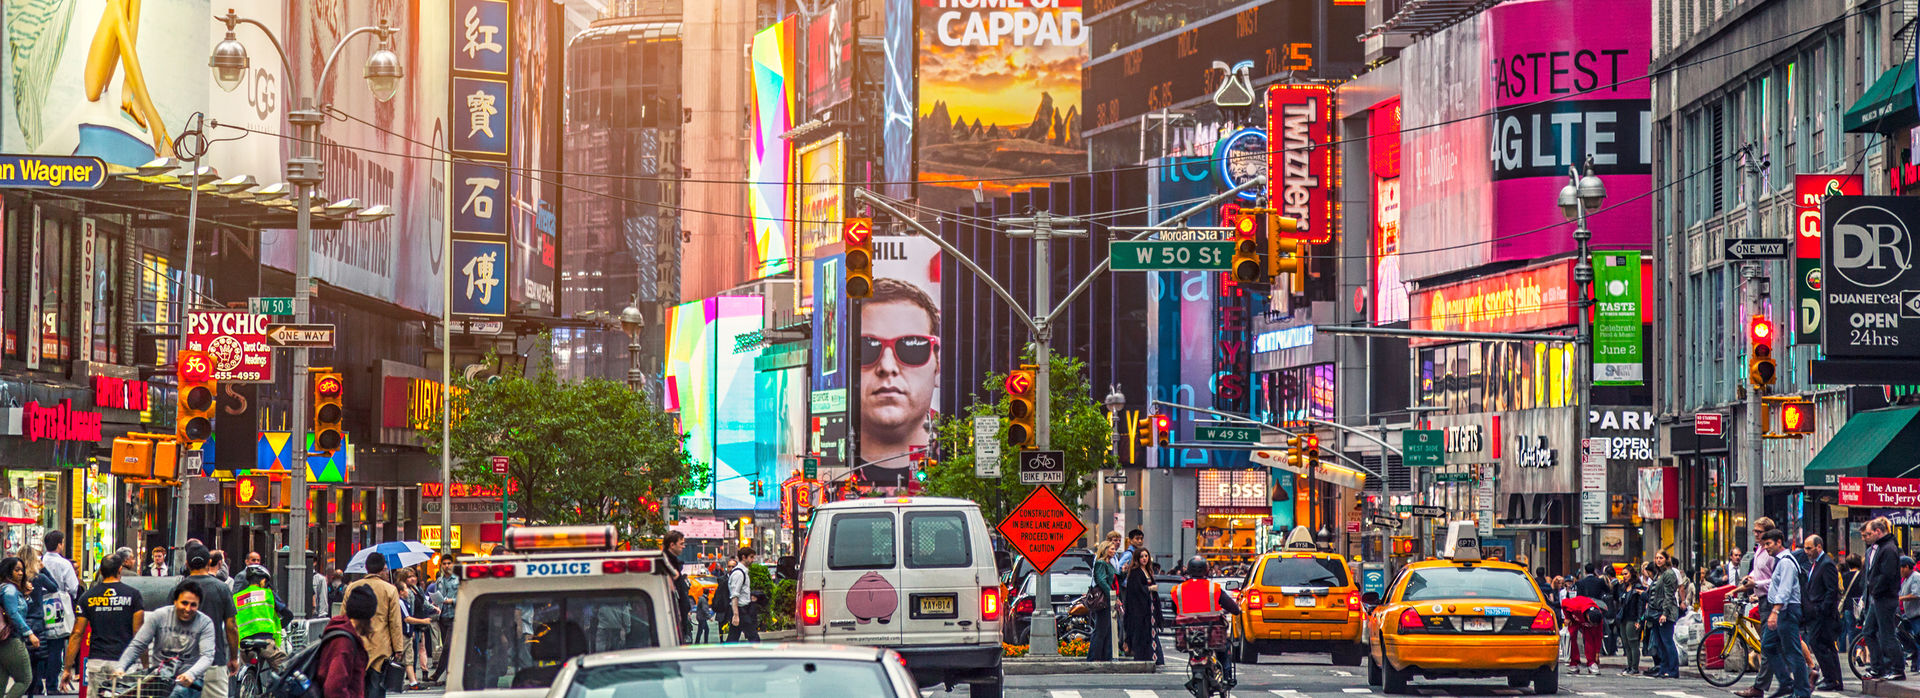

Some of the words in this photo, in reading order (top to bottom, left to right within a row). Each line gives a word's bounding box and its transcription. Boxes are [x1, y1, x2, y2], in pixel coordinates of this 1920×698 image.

[1491, 50, 1629, 99] FASTEST
[1490, 115, 1522, 171] 4G
[1532, 111, 1617, 168] LTE
[19, 159, 93, 187] Wagner
[1736, 244, 1755, 254] ONE
[1758, 244, 1780, 254] WAY
[1136, 248, 1154, 264] W
[1162, 247, 1191, 264] 50
[1198, 247, 1222, 264] St
[261, 301, 270, 313] W
[272, 300, 284, 313] 50
[1447, 299, 1464, 325] new
[1465, 287, 1485, 331] york
[1485, 282, 1514, 328] sports
[1515, 276, 1541, 315] clubs
[1599, 302, 1636, 312] TASTE
[187, 312, 268, 336] PSYCHIC
[1849, 312, 1899, 329] OPEN
[1600, 324, 1636, 333] Celebrate
[278, 331, 299, 341] ONE
[304, 331, 325, 340] WAY
[1849, 329, 1900, 346] 24hrs
[1600, 346, 1627, 355] June
[1629, 345, 1637, 355] 2
[1207, 430, 1216, 439] W
[1219, 430, 1234, 439] 49
[1237, 430, 1249, 440] St
[1612, 437, 1649, 449] OPEN
[1612, 449, 1628, 460] 24
[1024, 473, 1040, 481] BIKE
[1042, 472, 1061, 481] PATH
[1867, 483, 1884, 493] The
[1885, 483, 1908, 493] Anne
[1878, 493, 1895, 503] The
[1894, 493, 1915, 505] Jerry
[1019, 509, 1064, 518] CONSTRUCTION
[1012, 521, 1019, 529] IN
[1020, 521, 1034, 529] BIKE
[1034, 521, 1050, 529] LANE
[1051, 521, 1072, 529] AHEAD
[1021, 532, 1048, 541] PROCEED
[1049, 532, 1064, 541] WITH
[1029, 544, 1055, 553] CAUTION
[526, 562, 591, 576] POLICE
[88, 596, 109, 607] SAPO
[109, 596, 132, 606] TEAM
